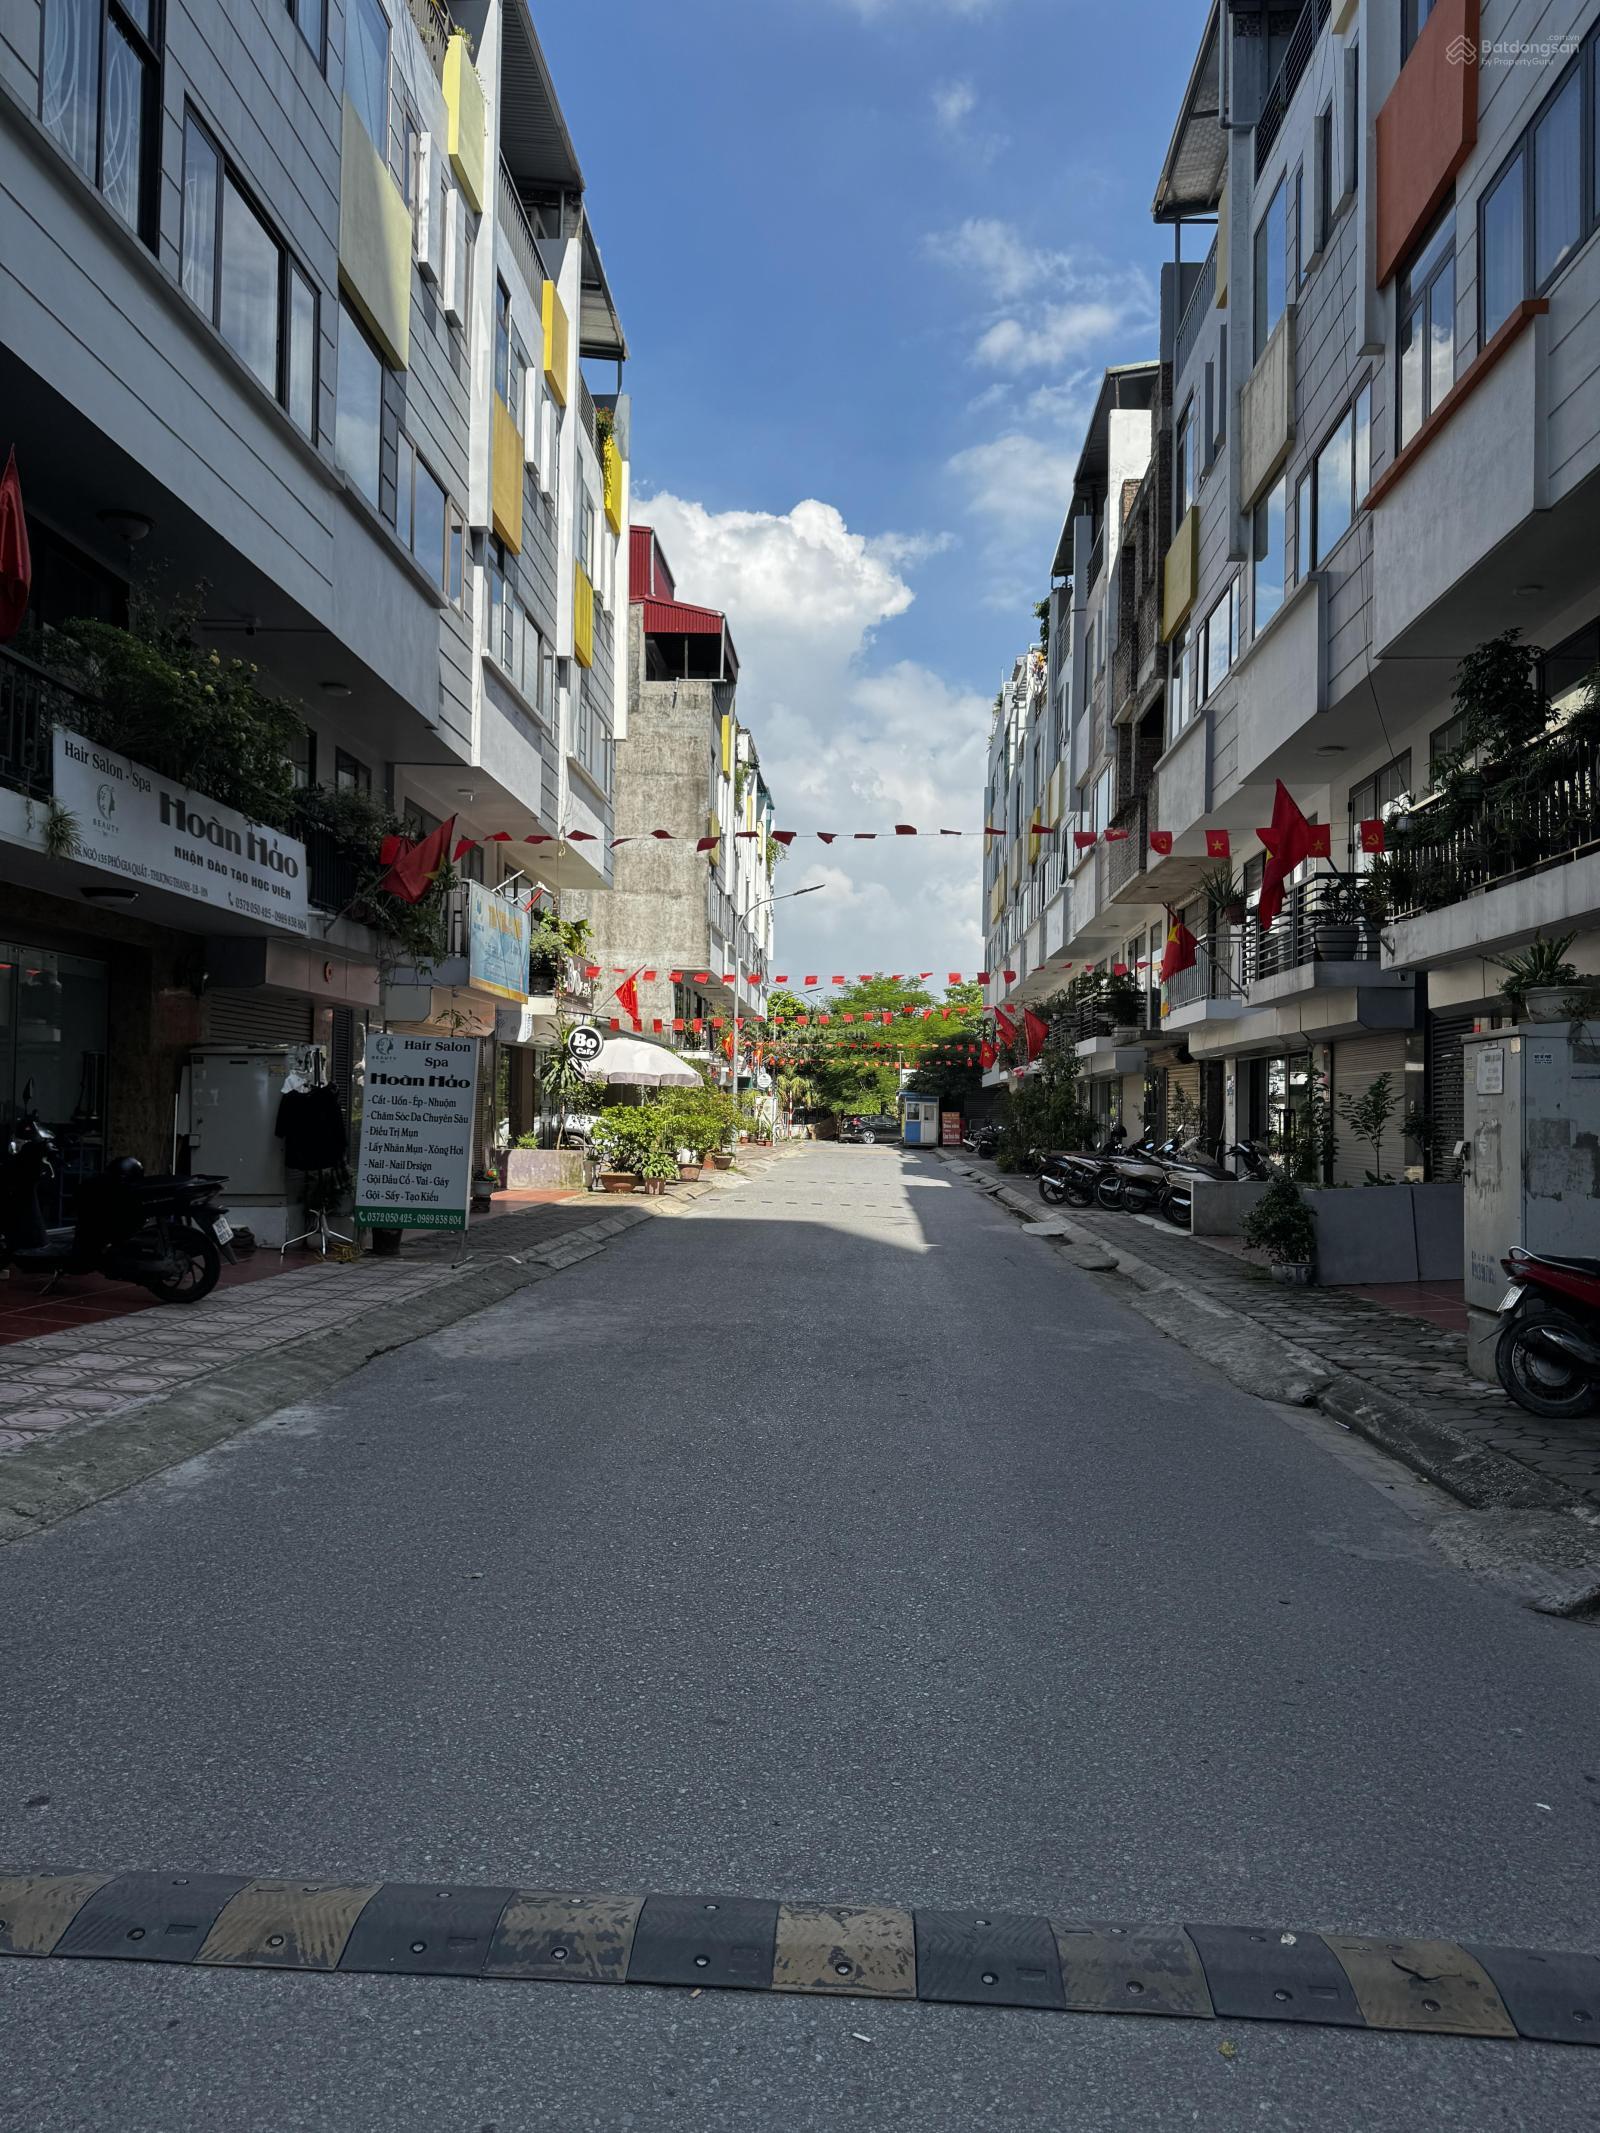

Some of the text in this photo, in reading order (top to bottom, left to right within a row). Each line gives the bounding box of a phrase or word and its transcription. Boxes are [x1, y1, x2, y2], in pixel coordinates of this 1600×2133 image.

[64, 740, 151, 793] Hair Salon Spa
[92, 817, 120, 833] BEAUTY
[159, 791, 299, 879] Hoàn Hảo
[174, 845, 204, 867] NHẬN
[207, 858, 228, 876] ĐÀO
[231, 868, 249, 884] TẠO
[271, 883, 291, 900] VIÊN
[404, 1040, 471, 1053] Hair Salon
[573, 1032, 597, 1049] Bo
[575, 1047, 595, 1056] Cafe
[424, 1056, 449, 1069] Spa
[370, 1072, 471, 1089] Hoàn Hảo
[428, 1097, 457, 1109] Nhuộm
[411, 1112, 422, 1121] Da
[401, 1127, 419, 1139] Mụn
[405, 1143, 423, 1155] Mụn
[368, 1158, 384, 1169] Nail
[389, 1159, 405, 1170] Nail
[415, 1175, 429, 1186] Vai
[404, 1191, 420, 1203] Tạo
[367, 1212, 462, 1225] 0372 050 425 0989 838 804
